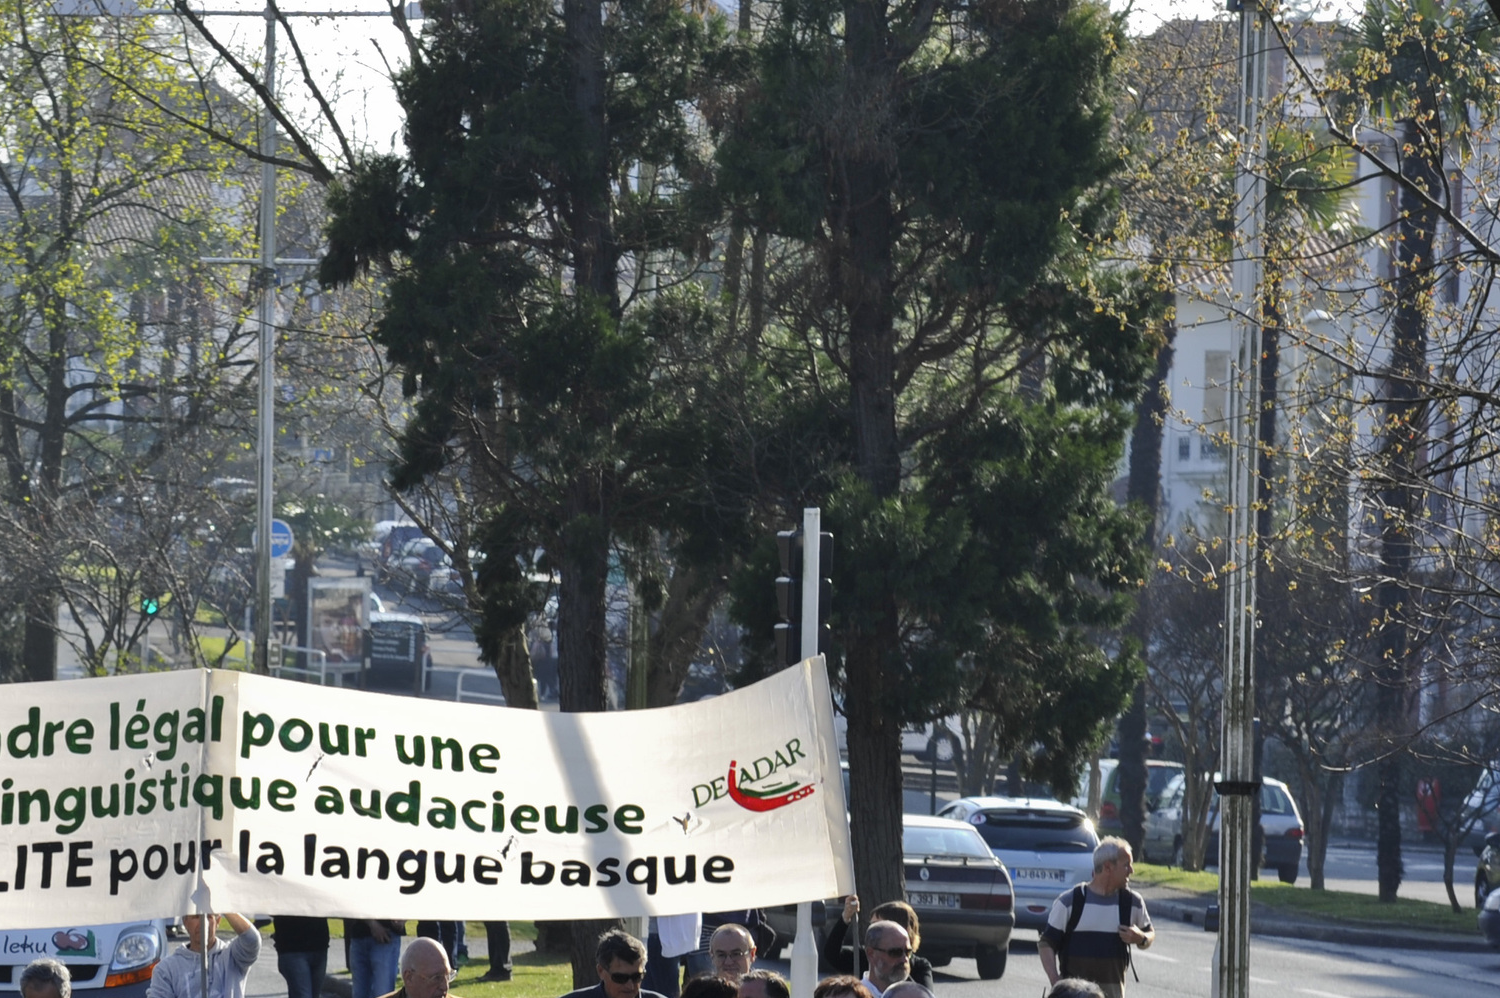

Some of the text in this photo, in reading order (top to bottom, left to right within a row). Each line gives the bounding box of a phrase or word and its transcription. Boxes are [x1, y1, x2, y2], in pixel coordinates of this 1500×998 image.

[108, 694, 225, 762] légal
[240, 710, 377, 759] pour
[394, 733, 502, 775] une
[314, 783, 646, 836] audacieuse
[108, 838, 223, 896] pour
[239, 829, 286, 877] la
[304, 833, 504, 896] langue
[520, 849, 736, 897] basque
[3, 934, 48, 955] leku
